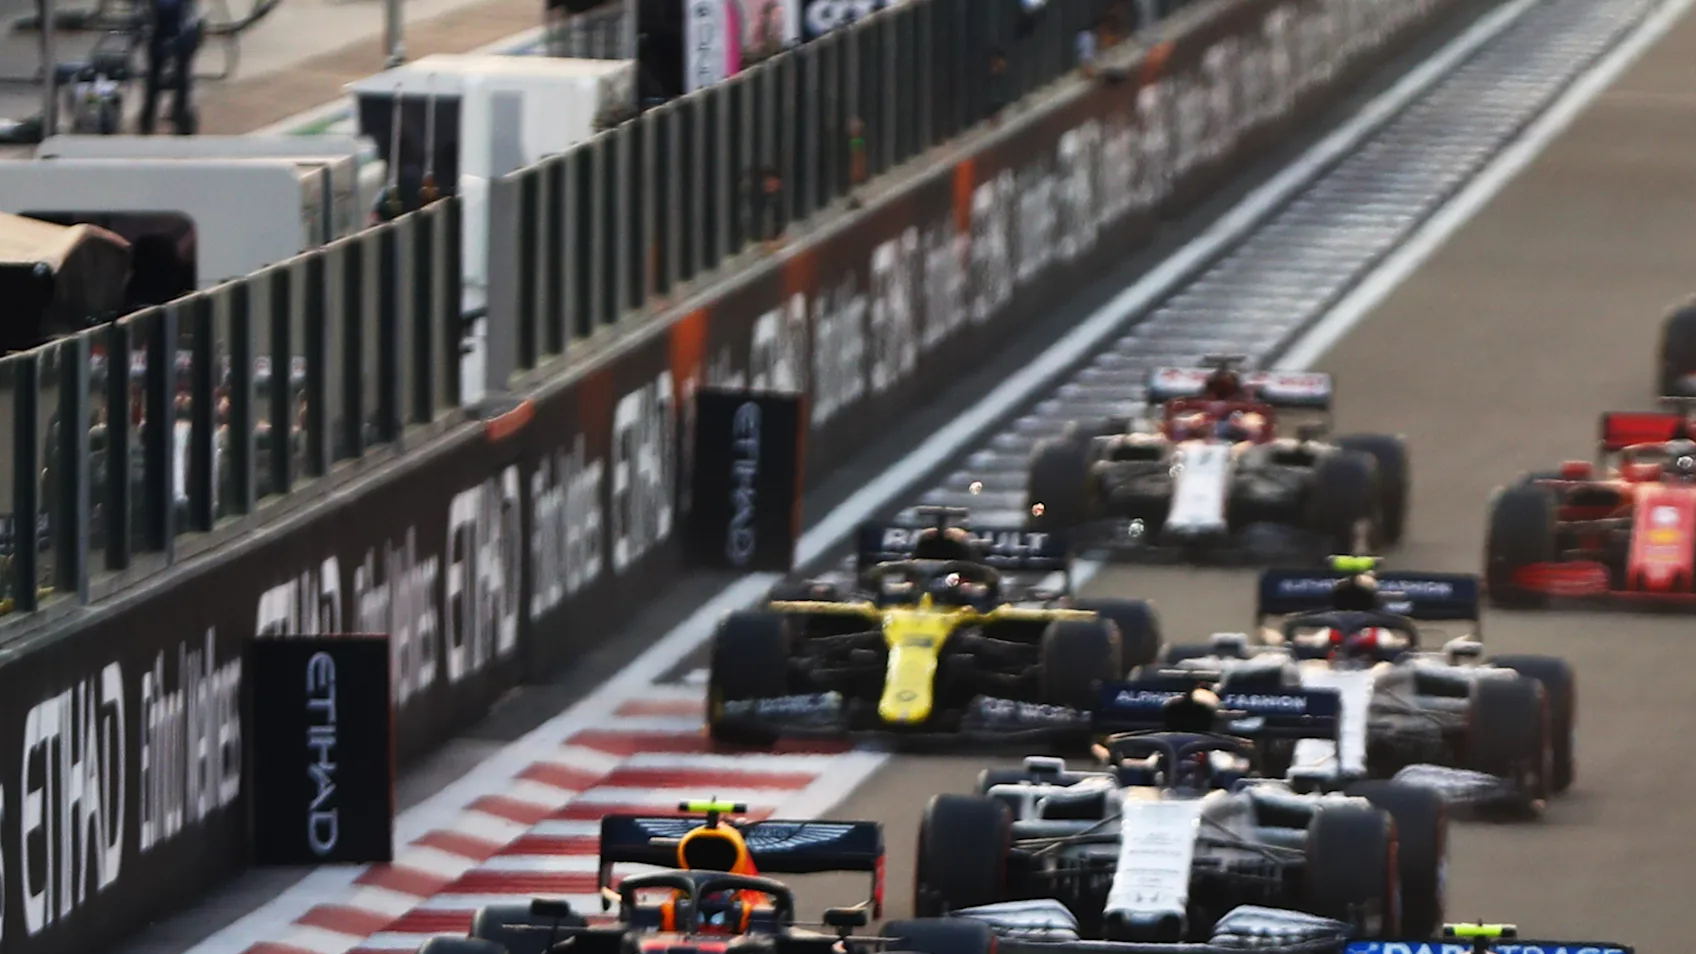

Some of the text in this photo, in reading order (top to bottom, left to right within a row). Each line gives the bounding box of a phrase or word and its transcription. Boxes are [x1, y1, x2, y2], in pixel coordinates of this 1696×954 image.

[21, 660, 126, 936] ETIHAD
[306, 651, 339, 856] ETIHAD
[1225, 695, 1308, 710] FASHION
